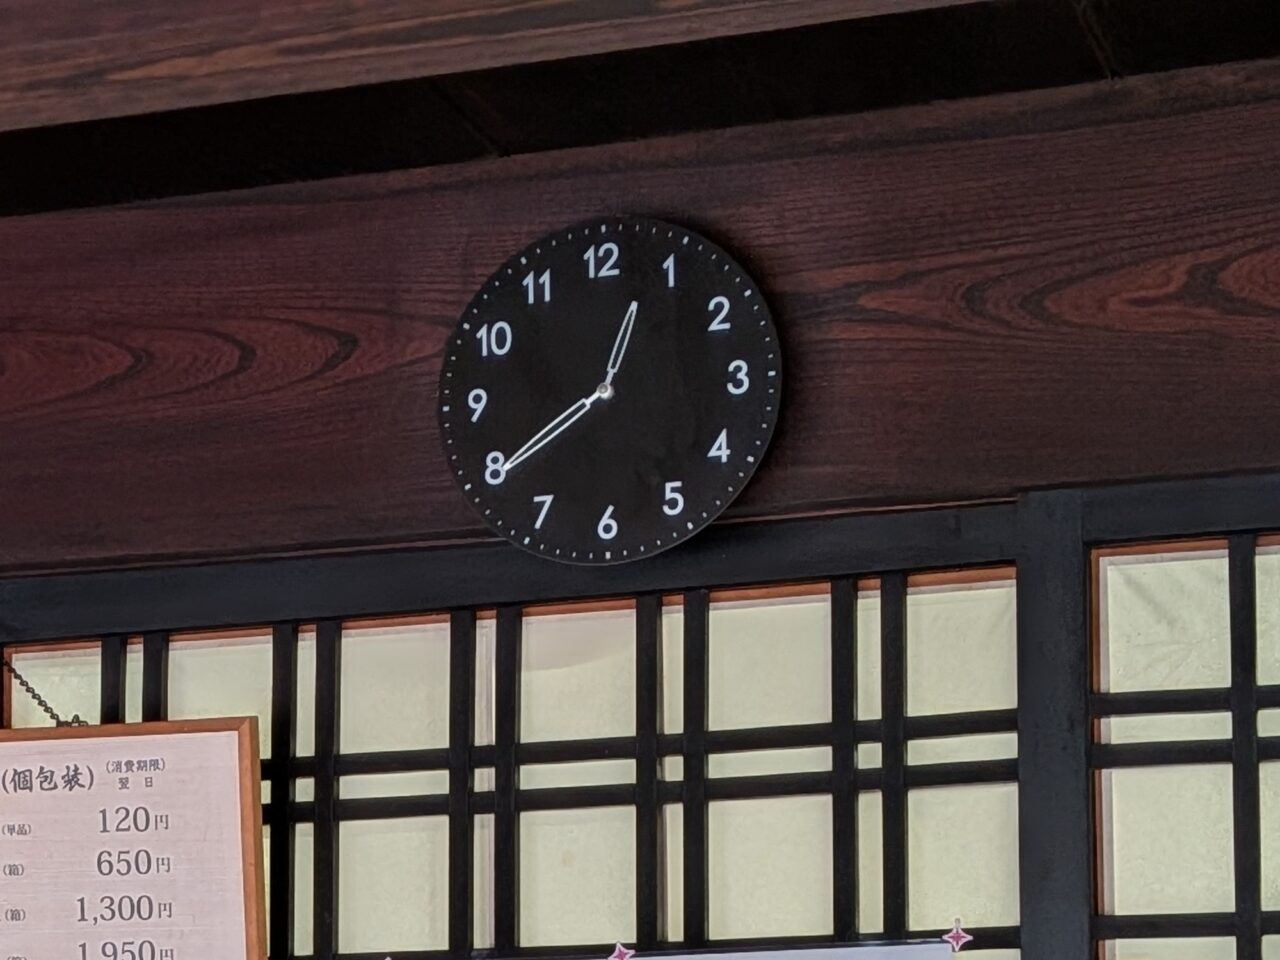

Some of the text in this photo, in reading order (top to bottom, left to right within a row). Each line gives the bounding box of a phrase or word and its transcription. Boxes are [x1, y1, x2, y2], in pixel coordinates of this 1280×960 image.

[583, 242, 620, 279] 12
[663, 253, 675, 288] 1
[522, 268, 551, 304] 11
[708, 296, 731, 331] 2
[476, 321, 512, 356] 10
[727, 360, 750, 395] 3
[468, 388, 488, 422] 9
[707, 428, 731, 463] 4
[485, 451, 506, 485] 8
[533, 494, 554, 529] 7
[663, 481, 684, 515] 5
[597, 505, 618, 540] 6
[98, 806, 169, 833] 120円
[97, 849, 171, 876] 650円
[76, 895, 172, 926] 1,300円
